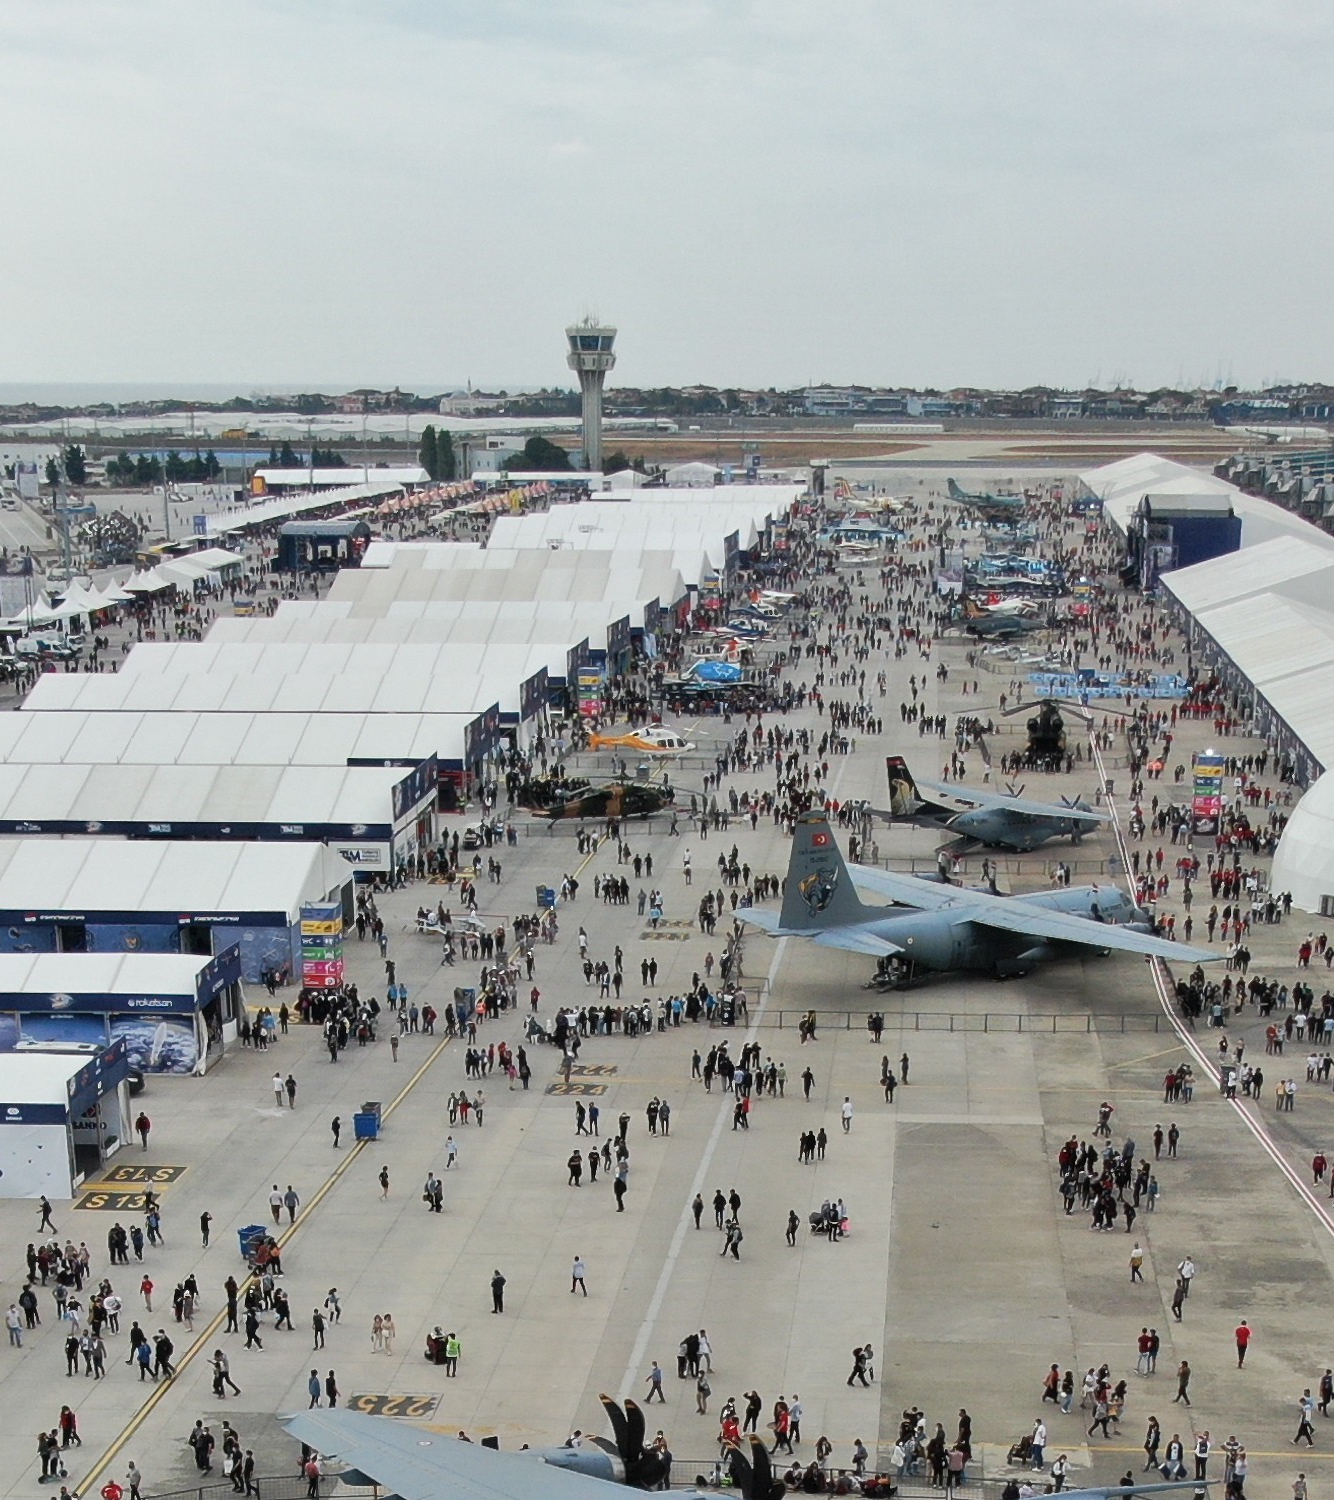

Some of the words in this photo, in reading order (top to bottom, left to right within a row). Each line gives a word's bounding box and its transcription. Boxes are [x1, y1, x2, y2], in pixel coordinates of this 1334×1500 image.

[135, 998, 173, 1008] roketsan
[551, 1084, 605, 1096] 224
[151, 1168, 174, 1181] S
[85, 1194, 110, 1208] S
[115, 1194, 146, 1208] 13
[357, 1394, 431, 1417] 225
